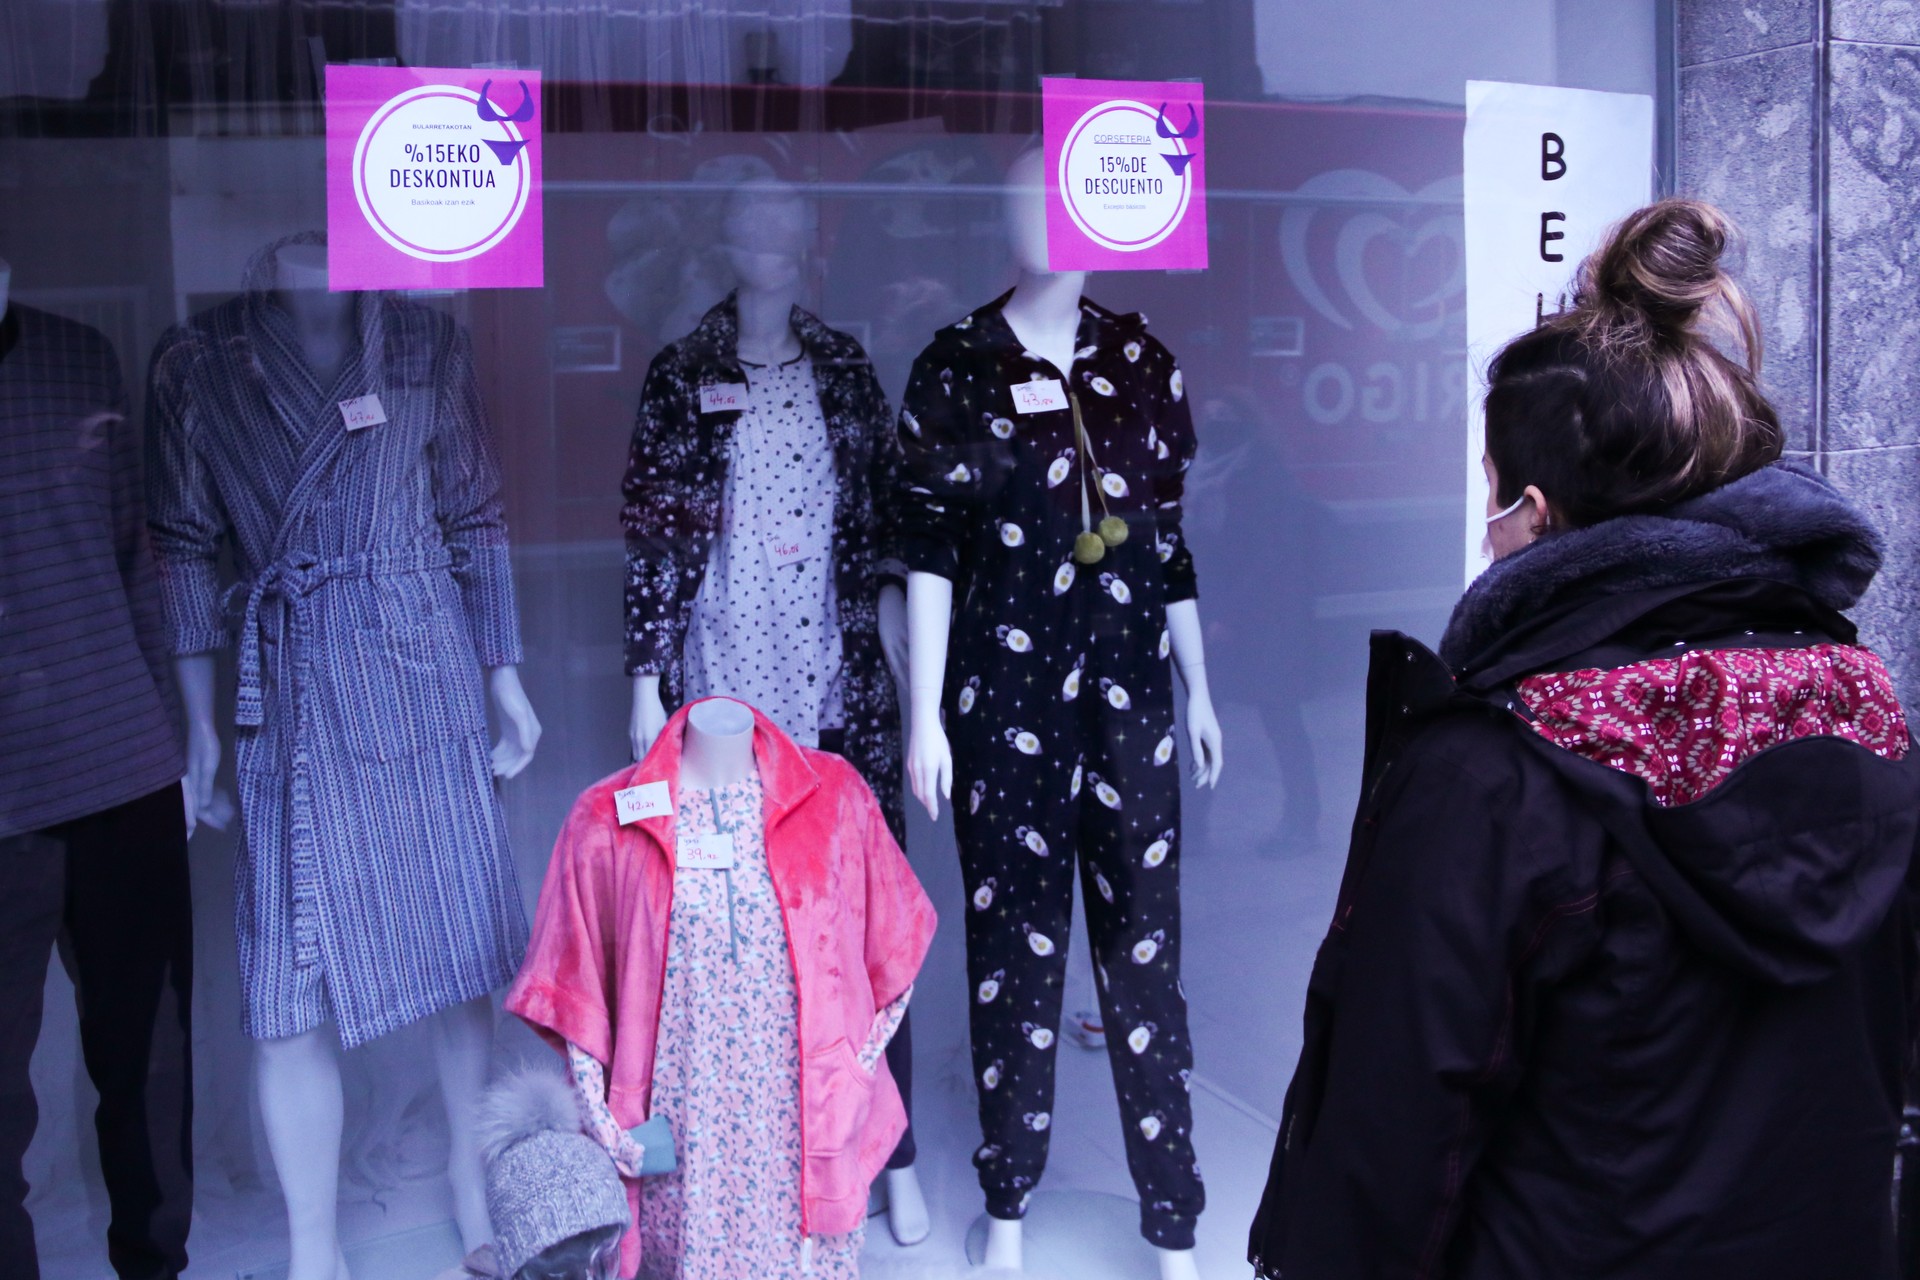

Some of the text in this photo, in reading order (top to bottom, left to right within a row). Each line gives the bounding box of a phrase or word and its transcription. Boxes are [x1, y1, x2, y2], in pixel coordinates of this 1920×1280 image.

[1094, 134, 1151, 143] CORSETERIA
[404, 144, 480, 163] %15EKO
[1100, 156, 1147, 173] 15%DE
[390, 169, 496, 188] DESKONTUA
[1085, 178, 1163, 195] DESCUENTO
